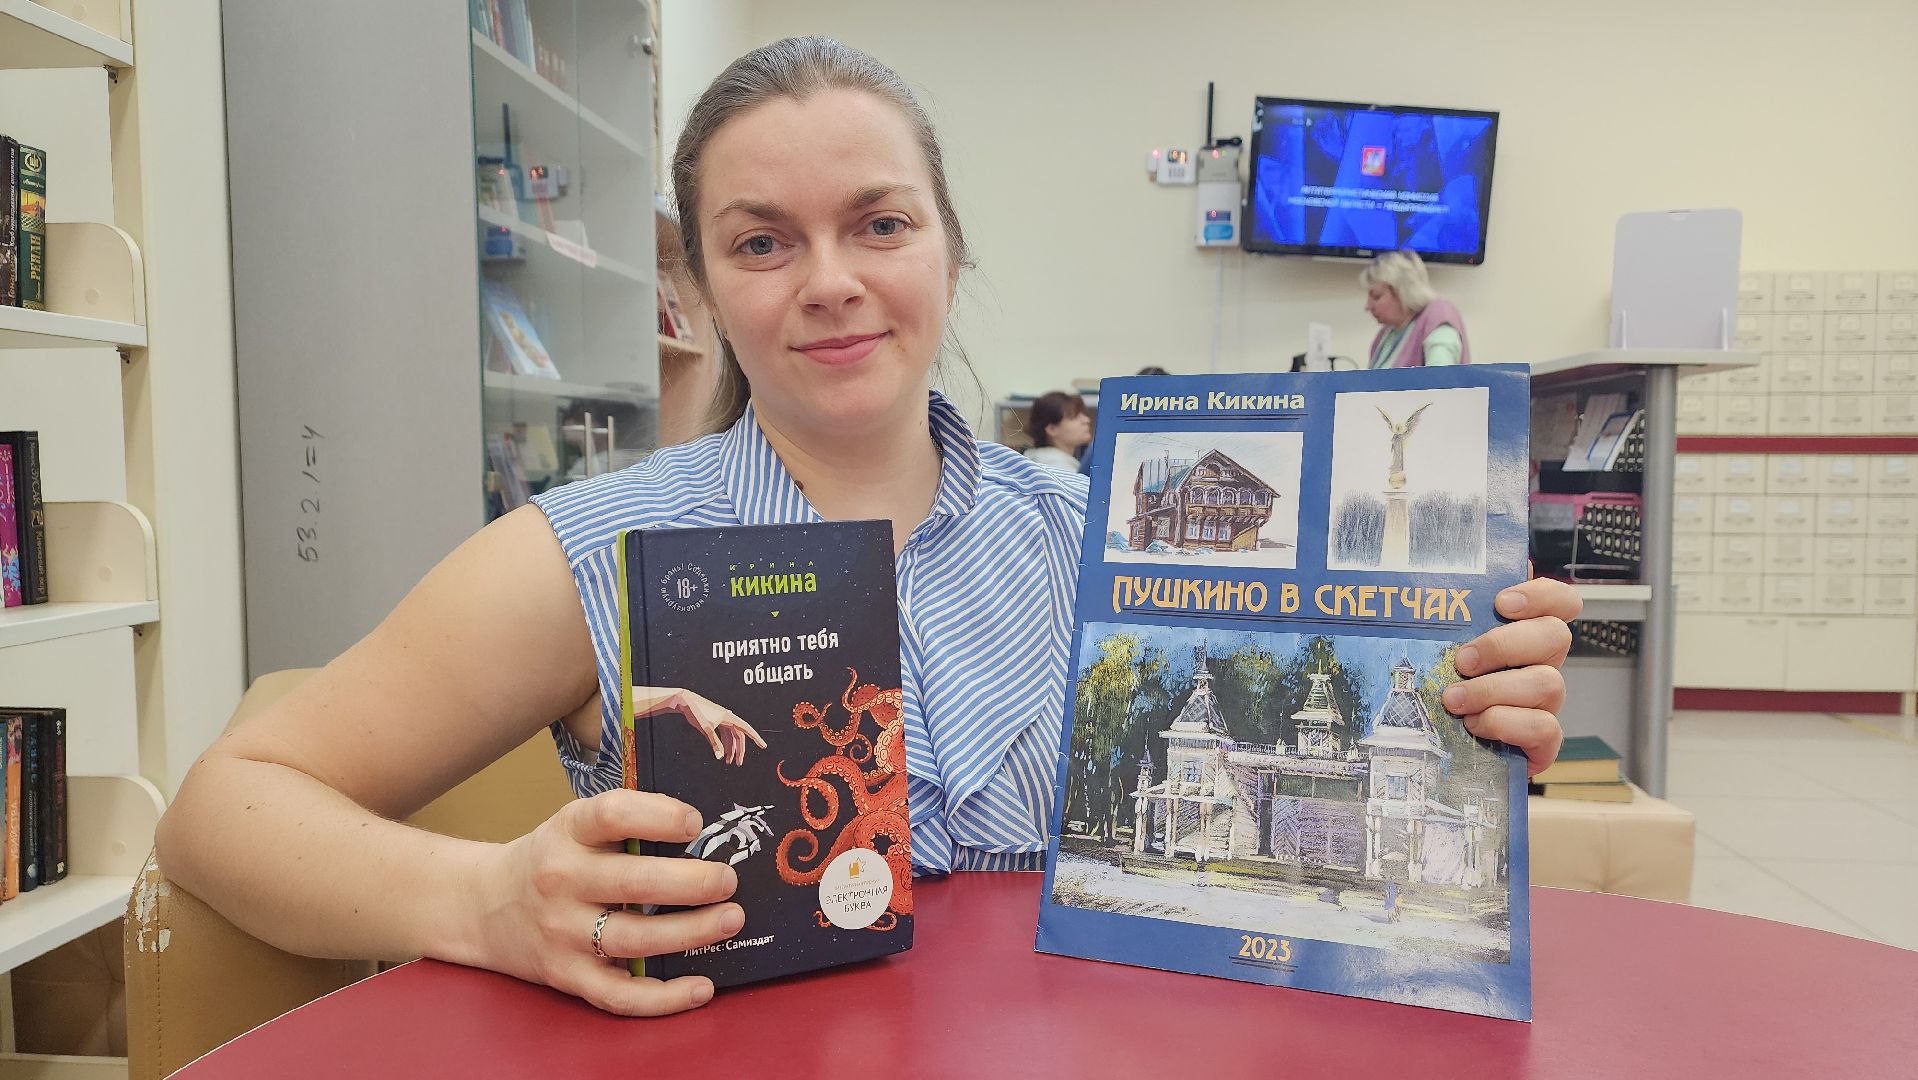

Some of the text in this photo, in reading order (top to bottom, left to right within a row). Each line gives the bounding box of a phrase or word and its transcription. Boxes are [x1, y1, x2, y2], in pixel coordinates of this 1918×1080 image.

[1120, 391, 1305, 414] Ирина Кикина
[677, 578, 699, 599] 18+
[1112, 576, 1472, 622] ПУШКИНО В СКЕТЧАХ
[712, 627, 839, 663] приятно тебя
[743, 661, 814, 685] общать
[826, 886, 888, 905] ЭЛЕКТРОННАЯ
[844, 901, 872, 913] БУКВА
[1239, 934, 1291, 962] 2023
